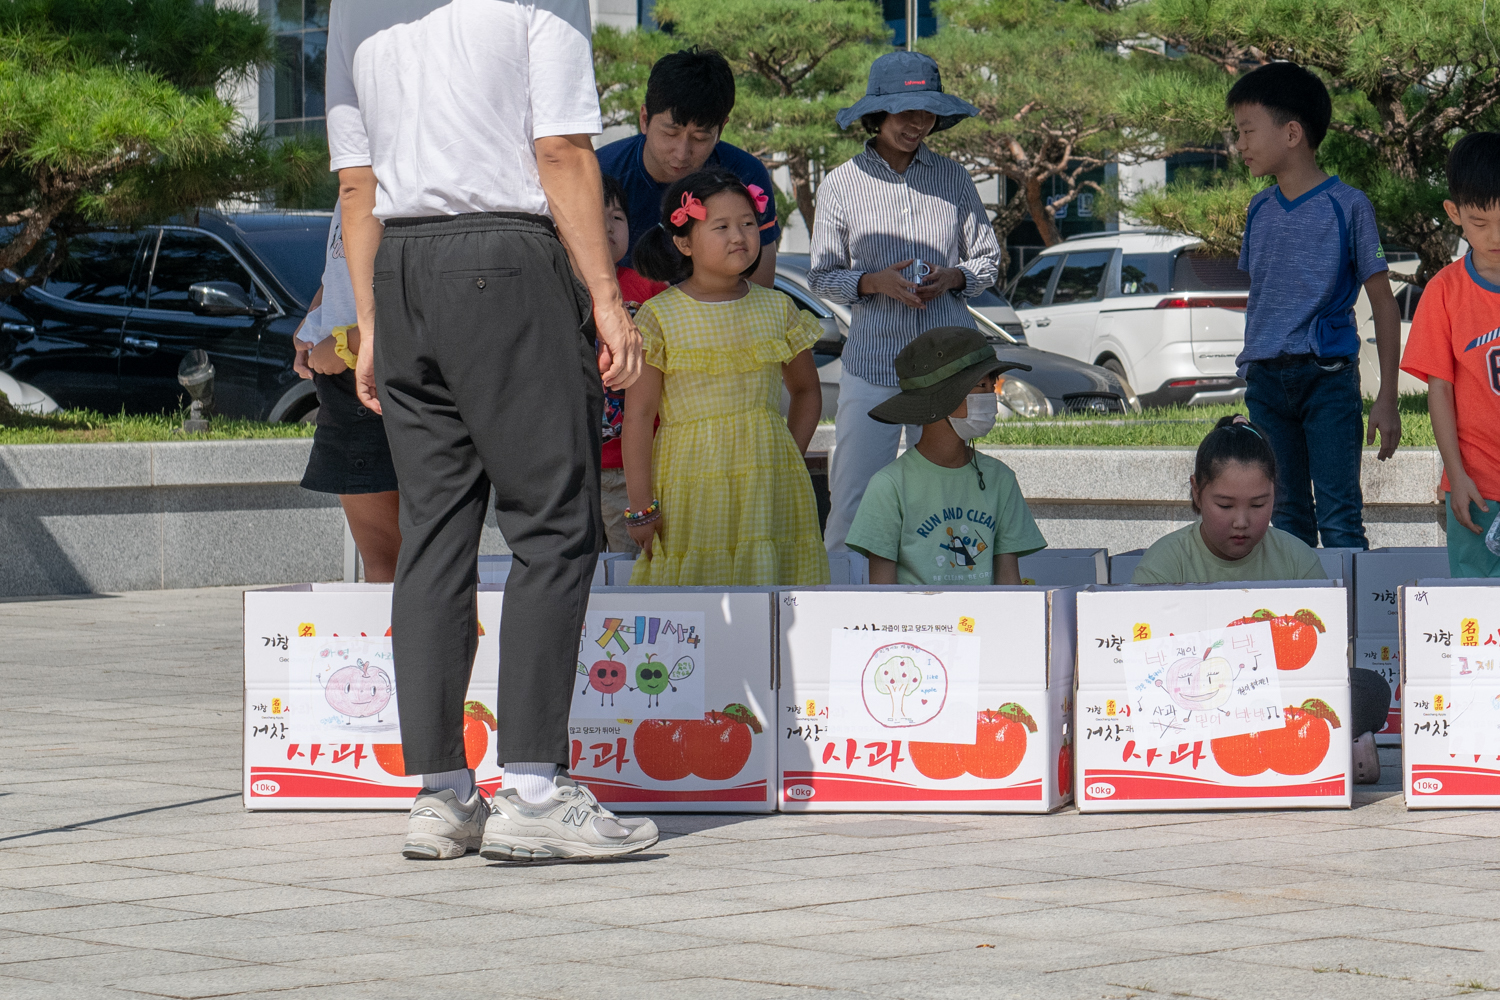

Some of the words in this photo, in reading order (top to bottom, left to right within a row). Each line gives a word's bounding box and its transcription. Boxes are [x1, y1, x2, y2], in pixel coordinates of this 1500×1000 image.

[916, 513, 942, 539] RUN
[942, 507, 963, 522] AND
[966, 508, 996, 533] CLEAN
[1372, 590, 1397, 605] 거창
[881, 624, 900, 633] 과즙이
[901, 624, 914, 632] 많고
[915, 624, 934, 633] 당도가
[935, 624, 954, 633] 뛰어난
[261, 633, 290, 650] 거창
[1095, 634, 1125, 651] 거창
[1423, 629, 1453, 646] 거창
[252, 703, 267, 713] 거창
[786, 705, 802, 714] 거창
[1085, 704, 1102, 714] 거창
[1152, 704, 1177, 717] 사과
[1413, 700, 1429, 709] 거창
[252, 723, 289, 740] 거창
[582, 726, 601, 735] 당도가
[602, 726, 620, 735] 뛰어난
[786, 724, 823, 742] 거창
[1086, 723, 1124, 742] 거창
[1413, 718, 1450, 737] 거창
[822, 738, 905, 773] 사과
[1122, 740, 1207, 770] 사과
[255, 783, 276, 792] 10kg
[1090, 786, 1111, 795] 10kg
[1416, 780, 1438, 790] 10kg
[790, 788, 812, 797] 10kg
